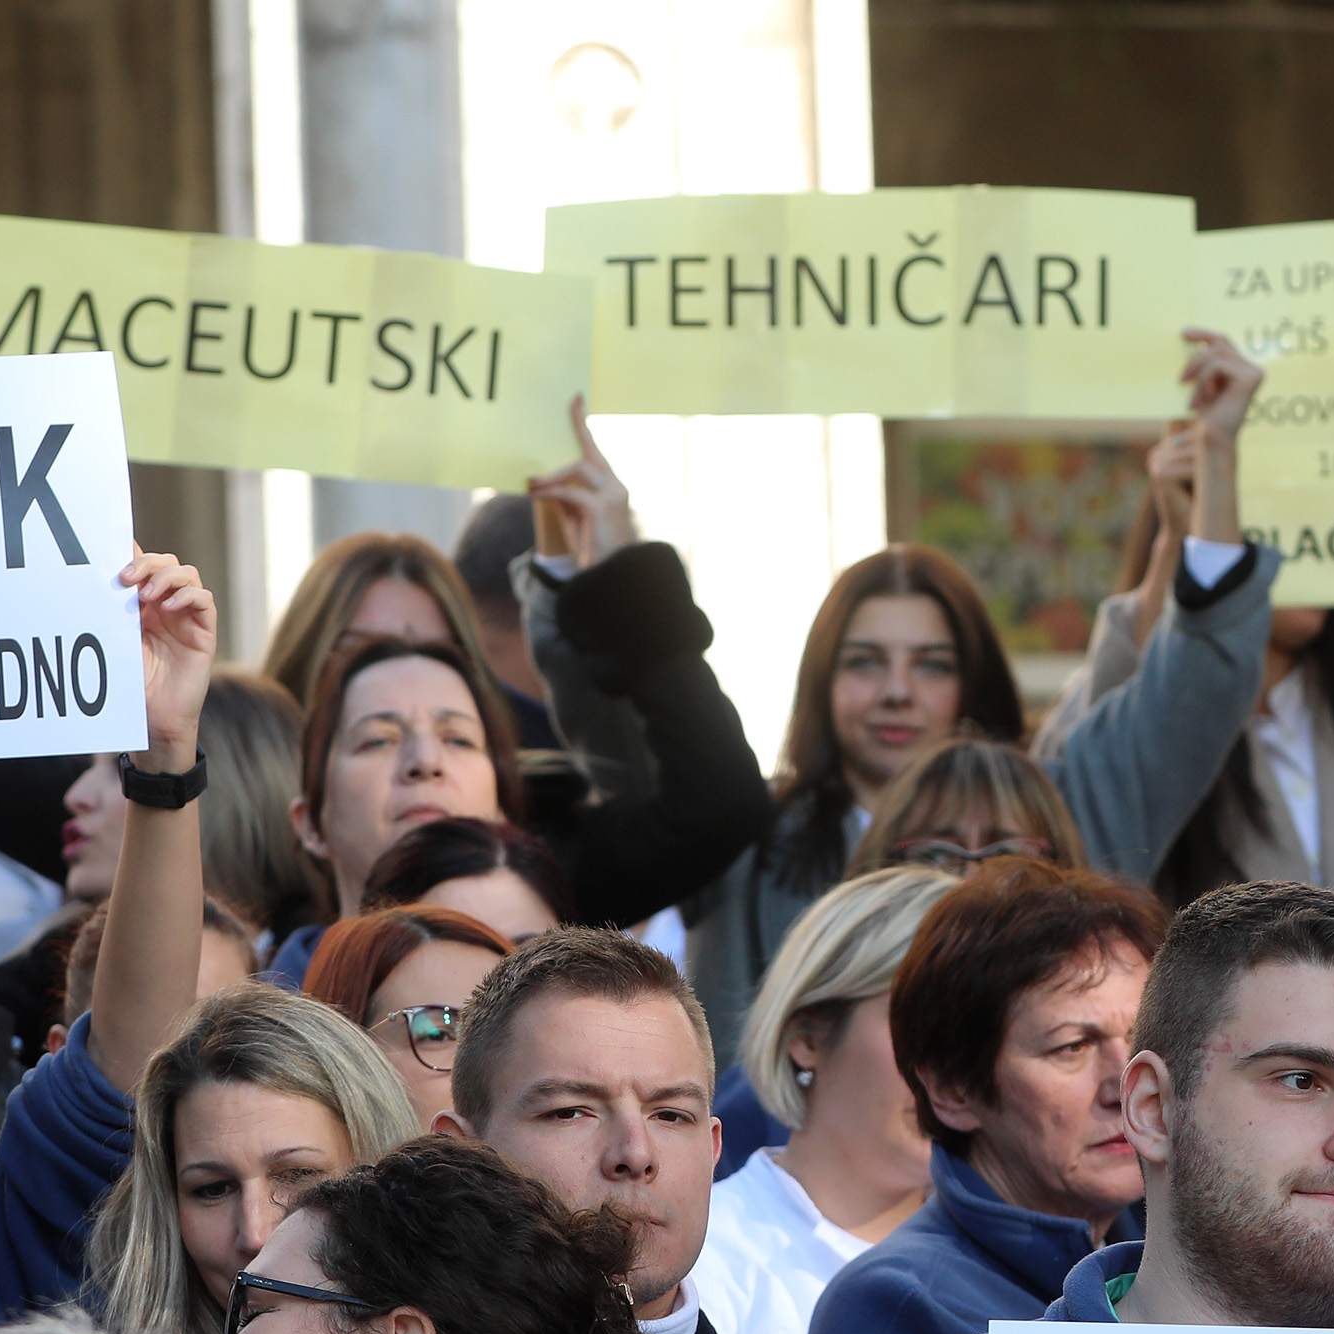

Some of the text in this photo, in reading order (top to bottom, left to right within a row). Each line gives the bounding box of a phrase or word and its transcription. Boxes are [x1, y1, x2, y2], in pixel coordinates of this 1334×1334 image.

[605, 232, 1110, 328] TEHNIČARI
[1226, 266, 1272, 298] ZA
[1244, 316, 1329, 355] UČIŠ
